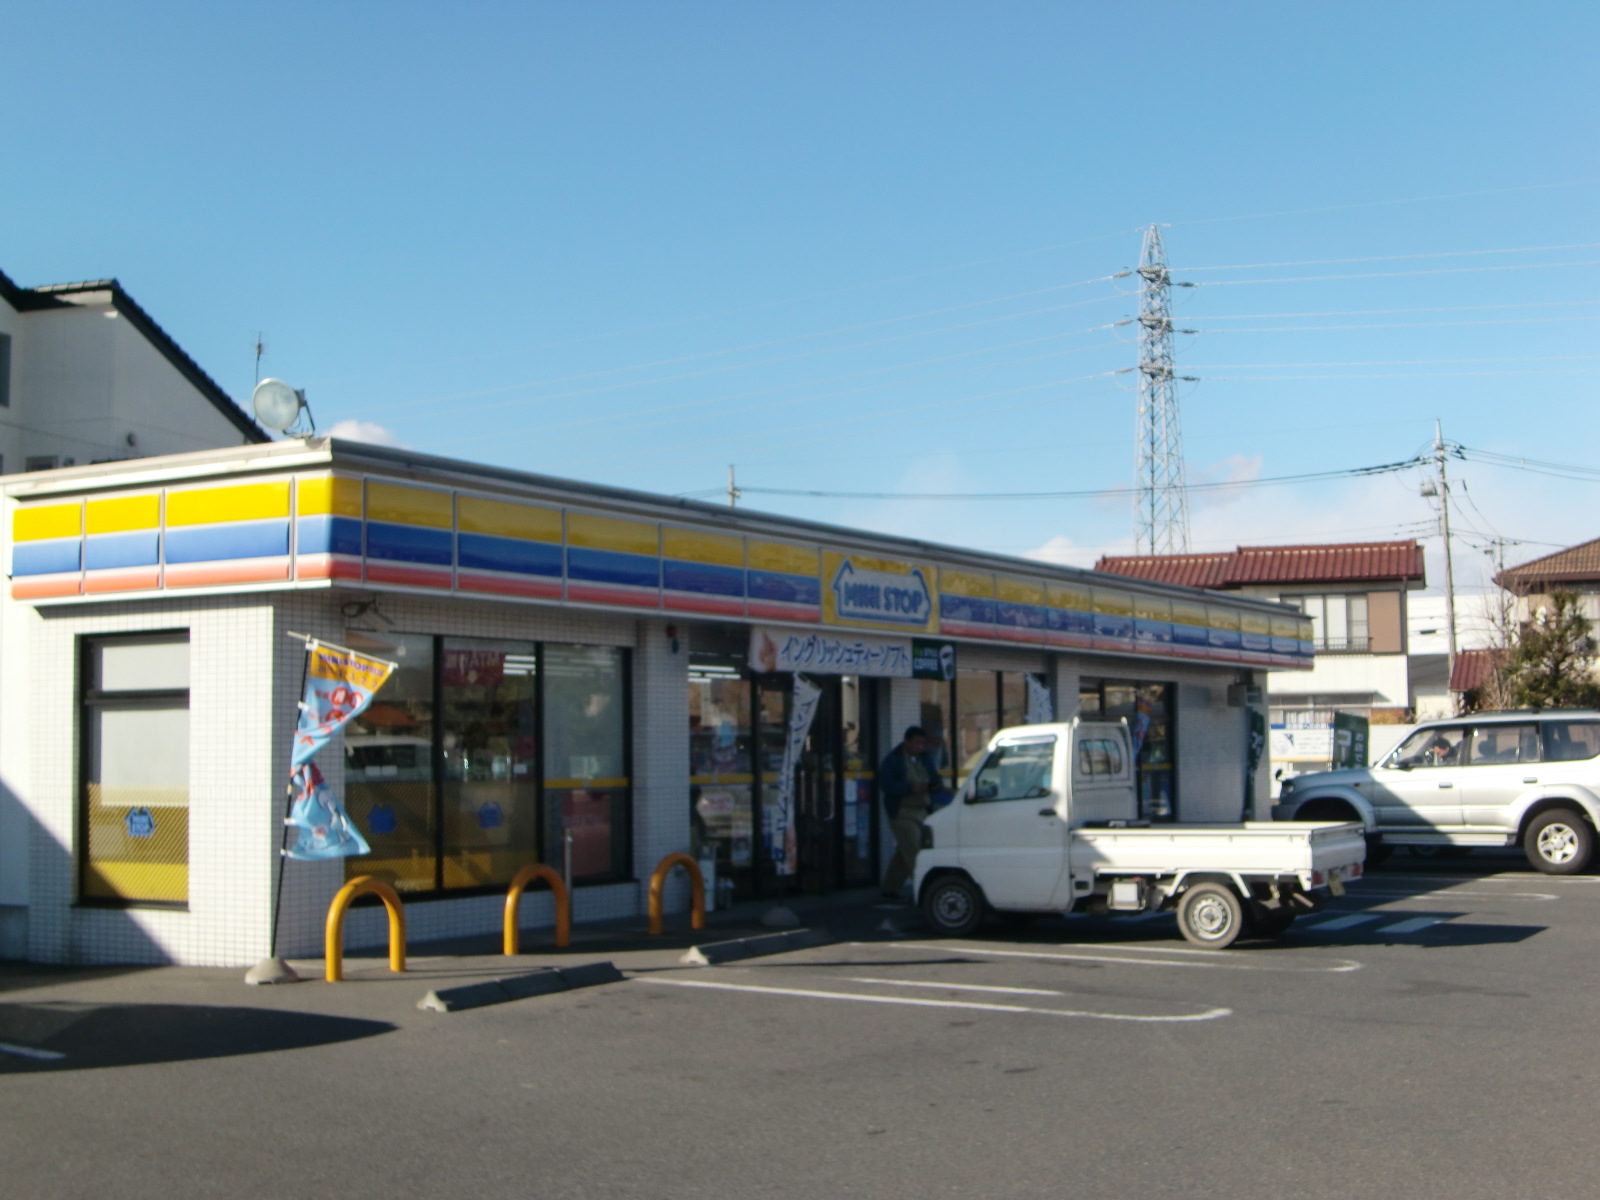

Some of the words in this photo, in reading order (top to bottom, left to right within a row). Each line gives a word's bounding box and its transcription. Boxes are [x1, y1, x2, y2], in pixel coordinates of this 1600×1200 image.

[844, 581, 880, 610] MINI
[883, 585, 922, 614] STOP
[781, 635, 907, 668] イングリッシュティーソフト
